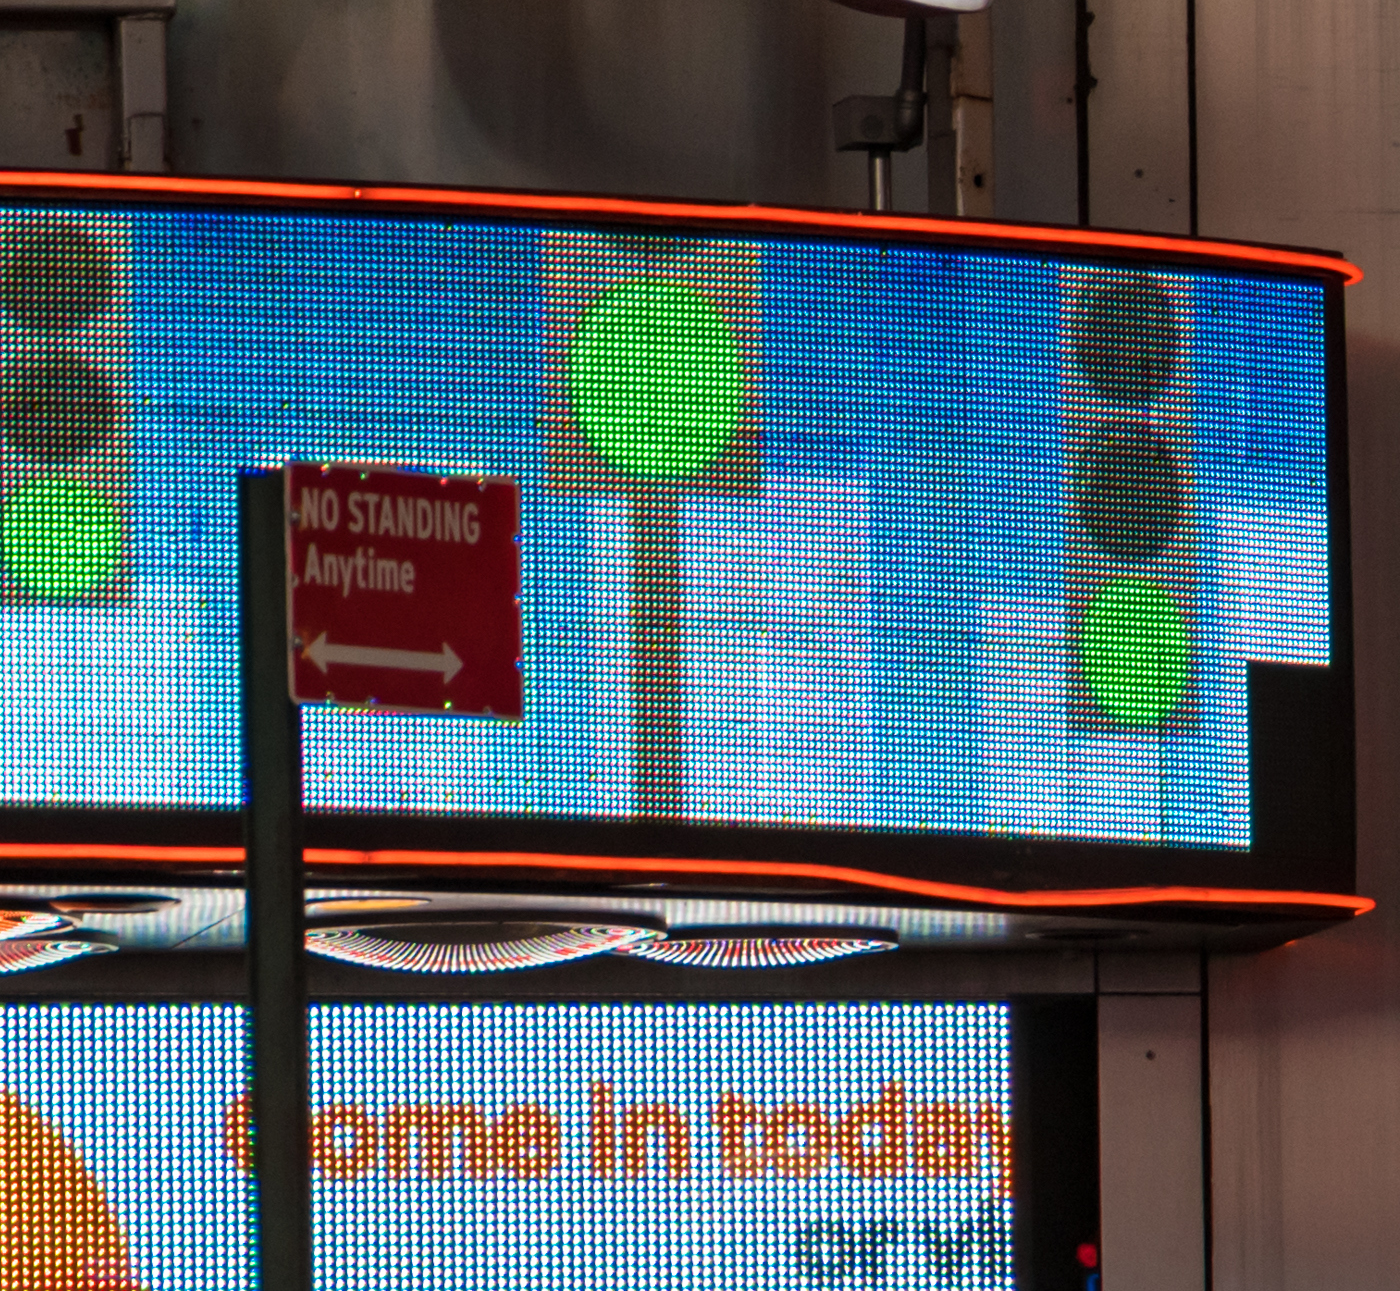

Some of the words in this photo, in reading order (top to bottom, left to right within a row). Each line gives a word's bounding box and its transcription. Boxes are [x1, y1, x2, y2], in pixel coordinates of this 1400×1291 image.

[301, 487, 339, 531] NO
[348, 491, 481, 545] STANDING
[304, 543, 416, 598] Anytime
[591, 1081, 690, 1179] in
